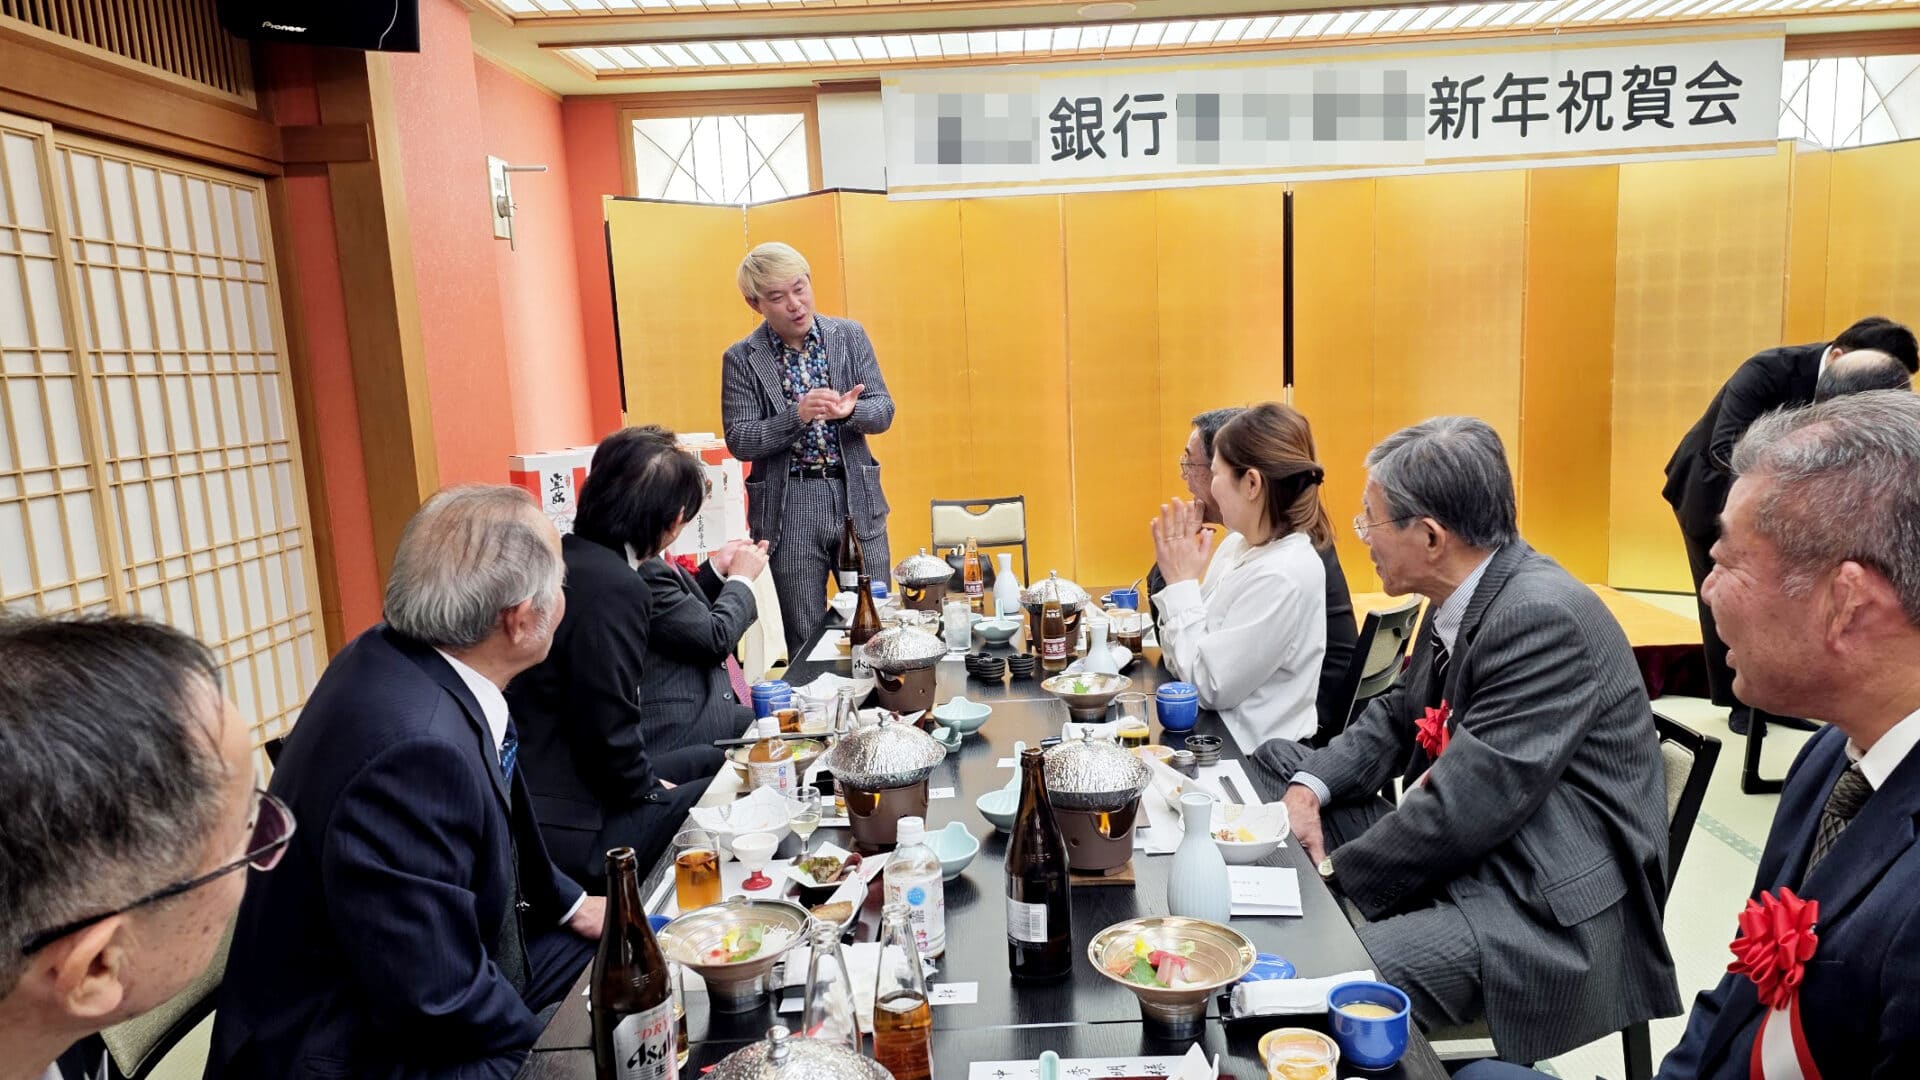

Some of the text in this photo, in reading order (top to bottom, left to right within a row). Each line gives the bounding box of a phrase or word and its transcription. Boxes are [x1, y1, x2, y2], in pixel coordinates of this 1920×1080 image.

[262, 21, 307, 32] Pioneer
[1048, 92, 1169, 161] 銀行
[1427, 60, 1744, 141] 新年祝賀会
